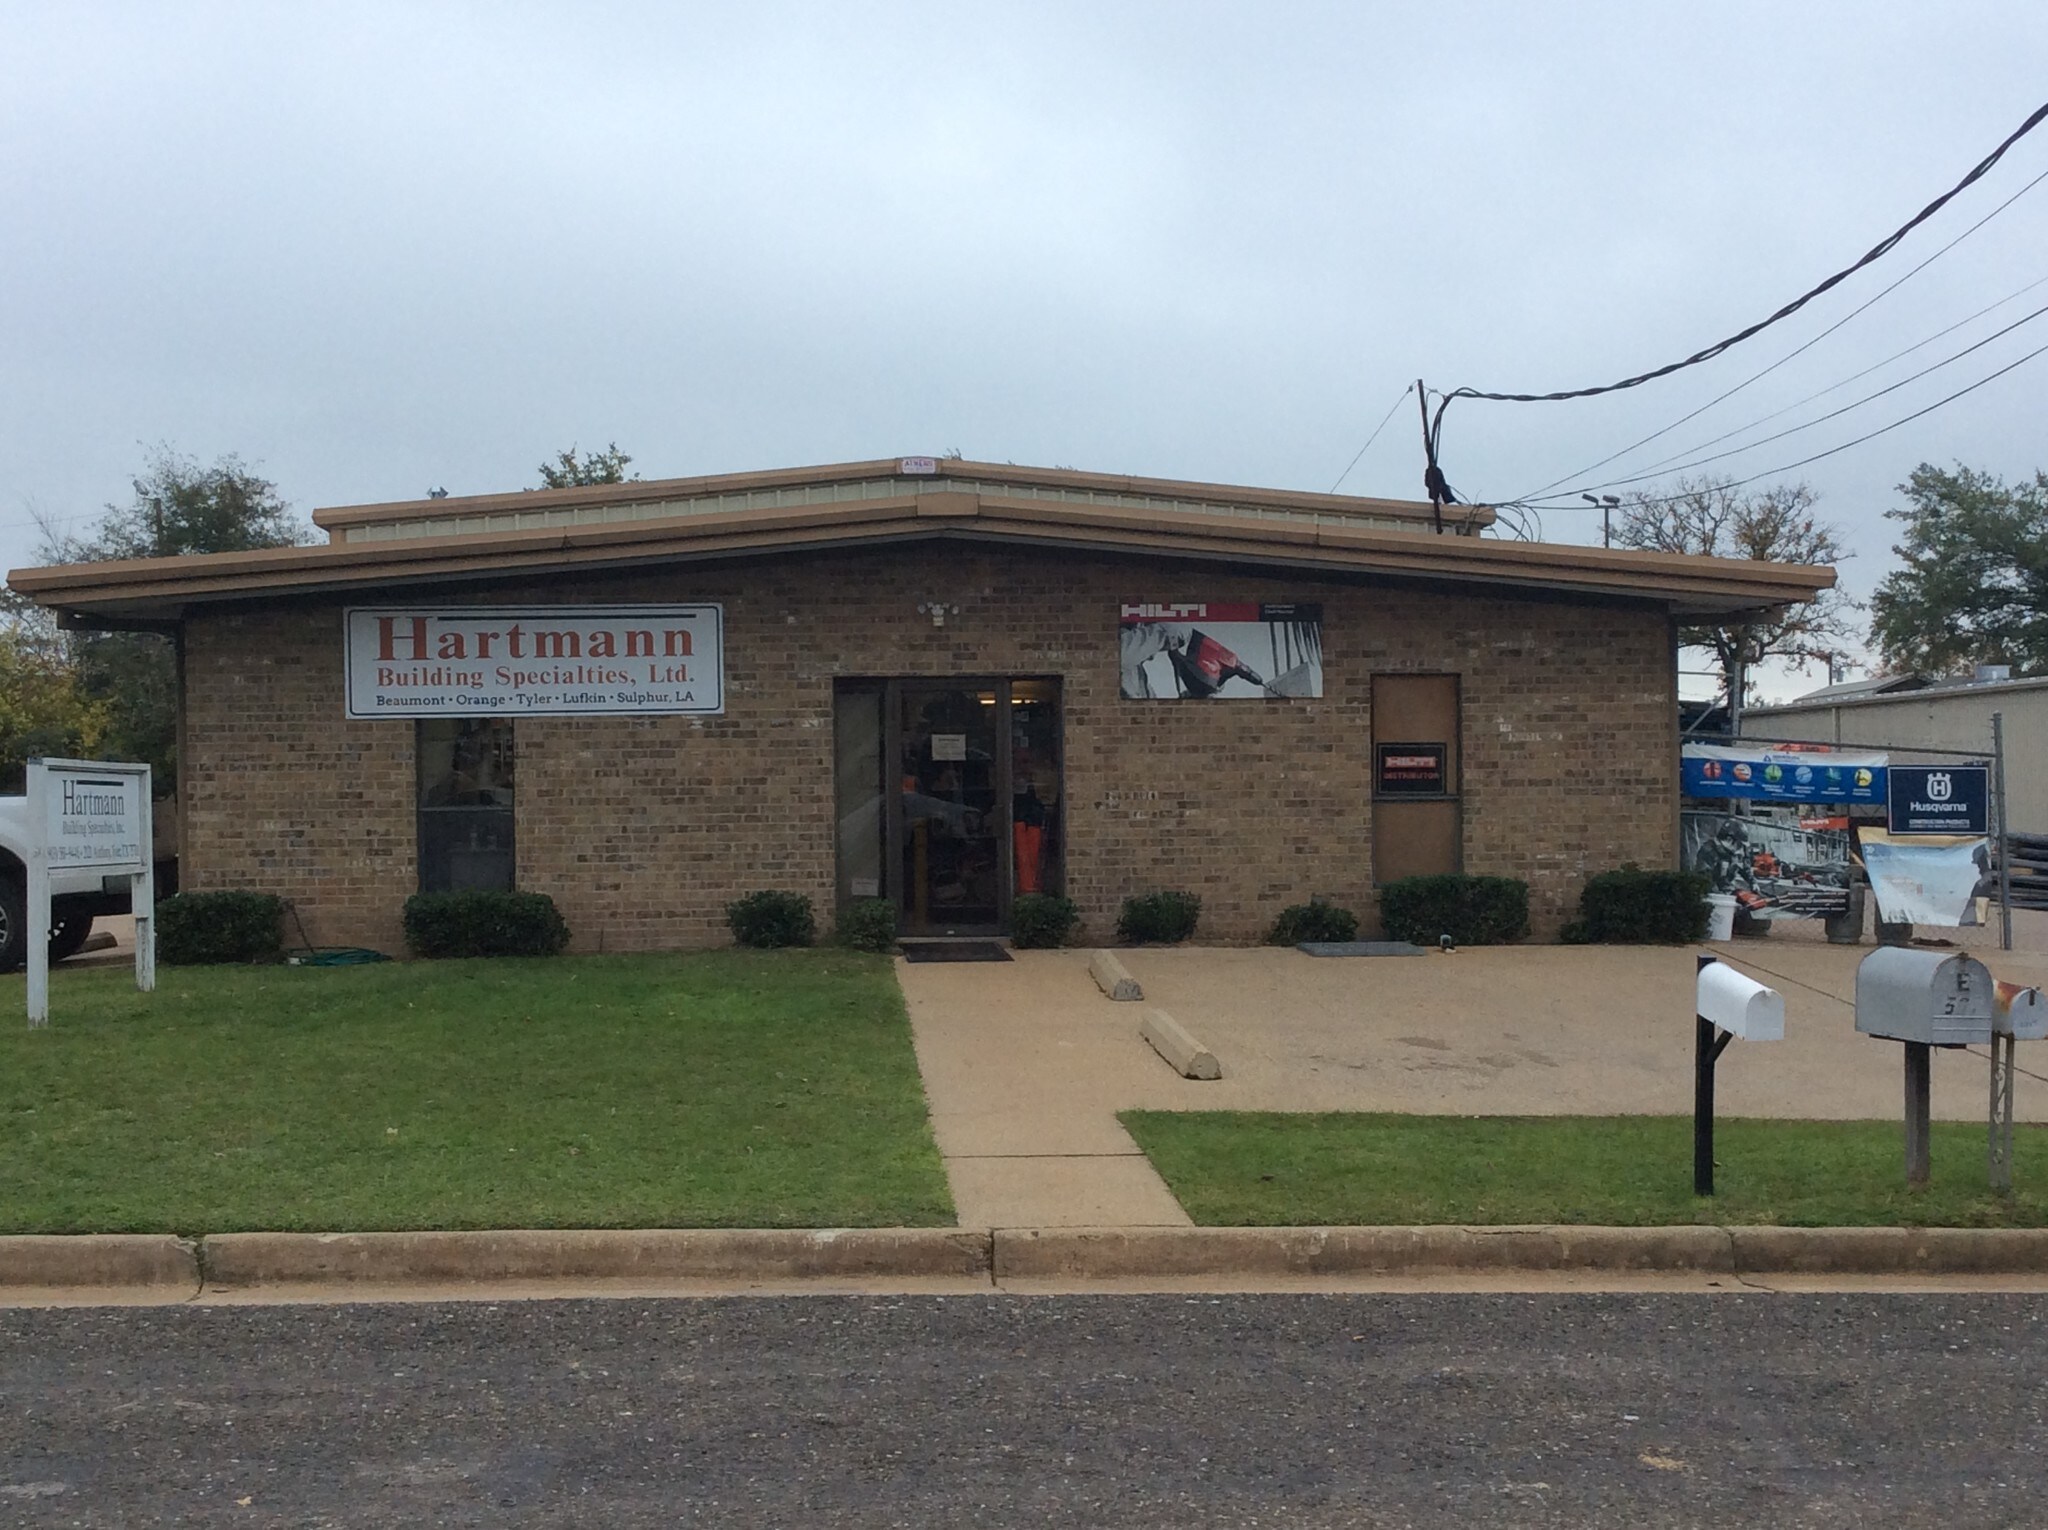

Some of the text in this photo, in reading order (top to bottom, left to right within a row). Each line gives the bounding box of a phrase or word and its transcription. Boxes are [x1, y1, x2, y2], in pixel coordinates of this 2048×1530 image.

[1121, 603, 1207, 617] HILTI
[373, 616, 695, 661] Hartmann
[377, 663, 695, 689] Building Specialties, Ltd.
[376, 690, 695, 707] Beaumont Orange Tyler Lufkin Sulphur, LA
[1385, 756, 1436, 768] HILTI
[62, 780, 125, 816] Hartmann
[1910, 801, 1968, 813] Husqvarna
